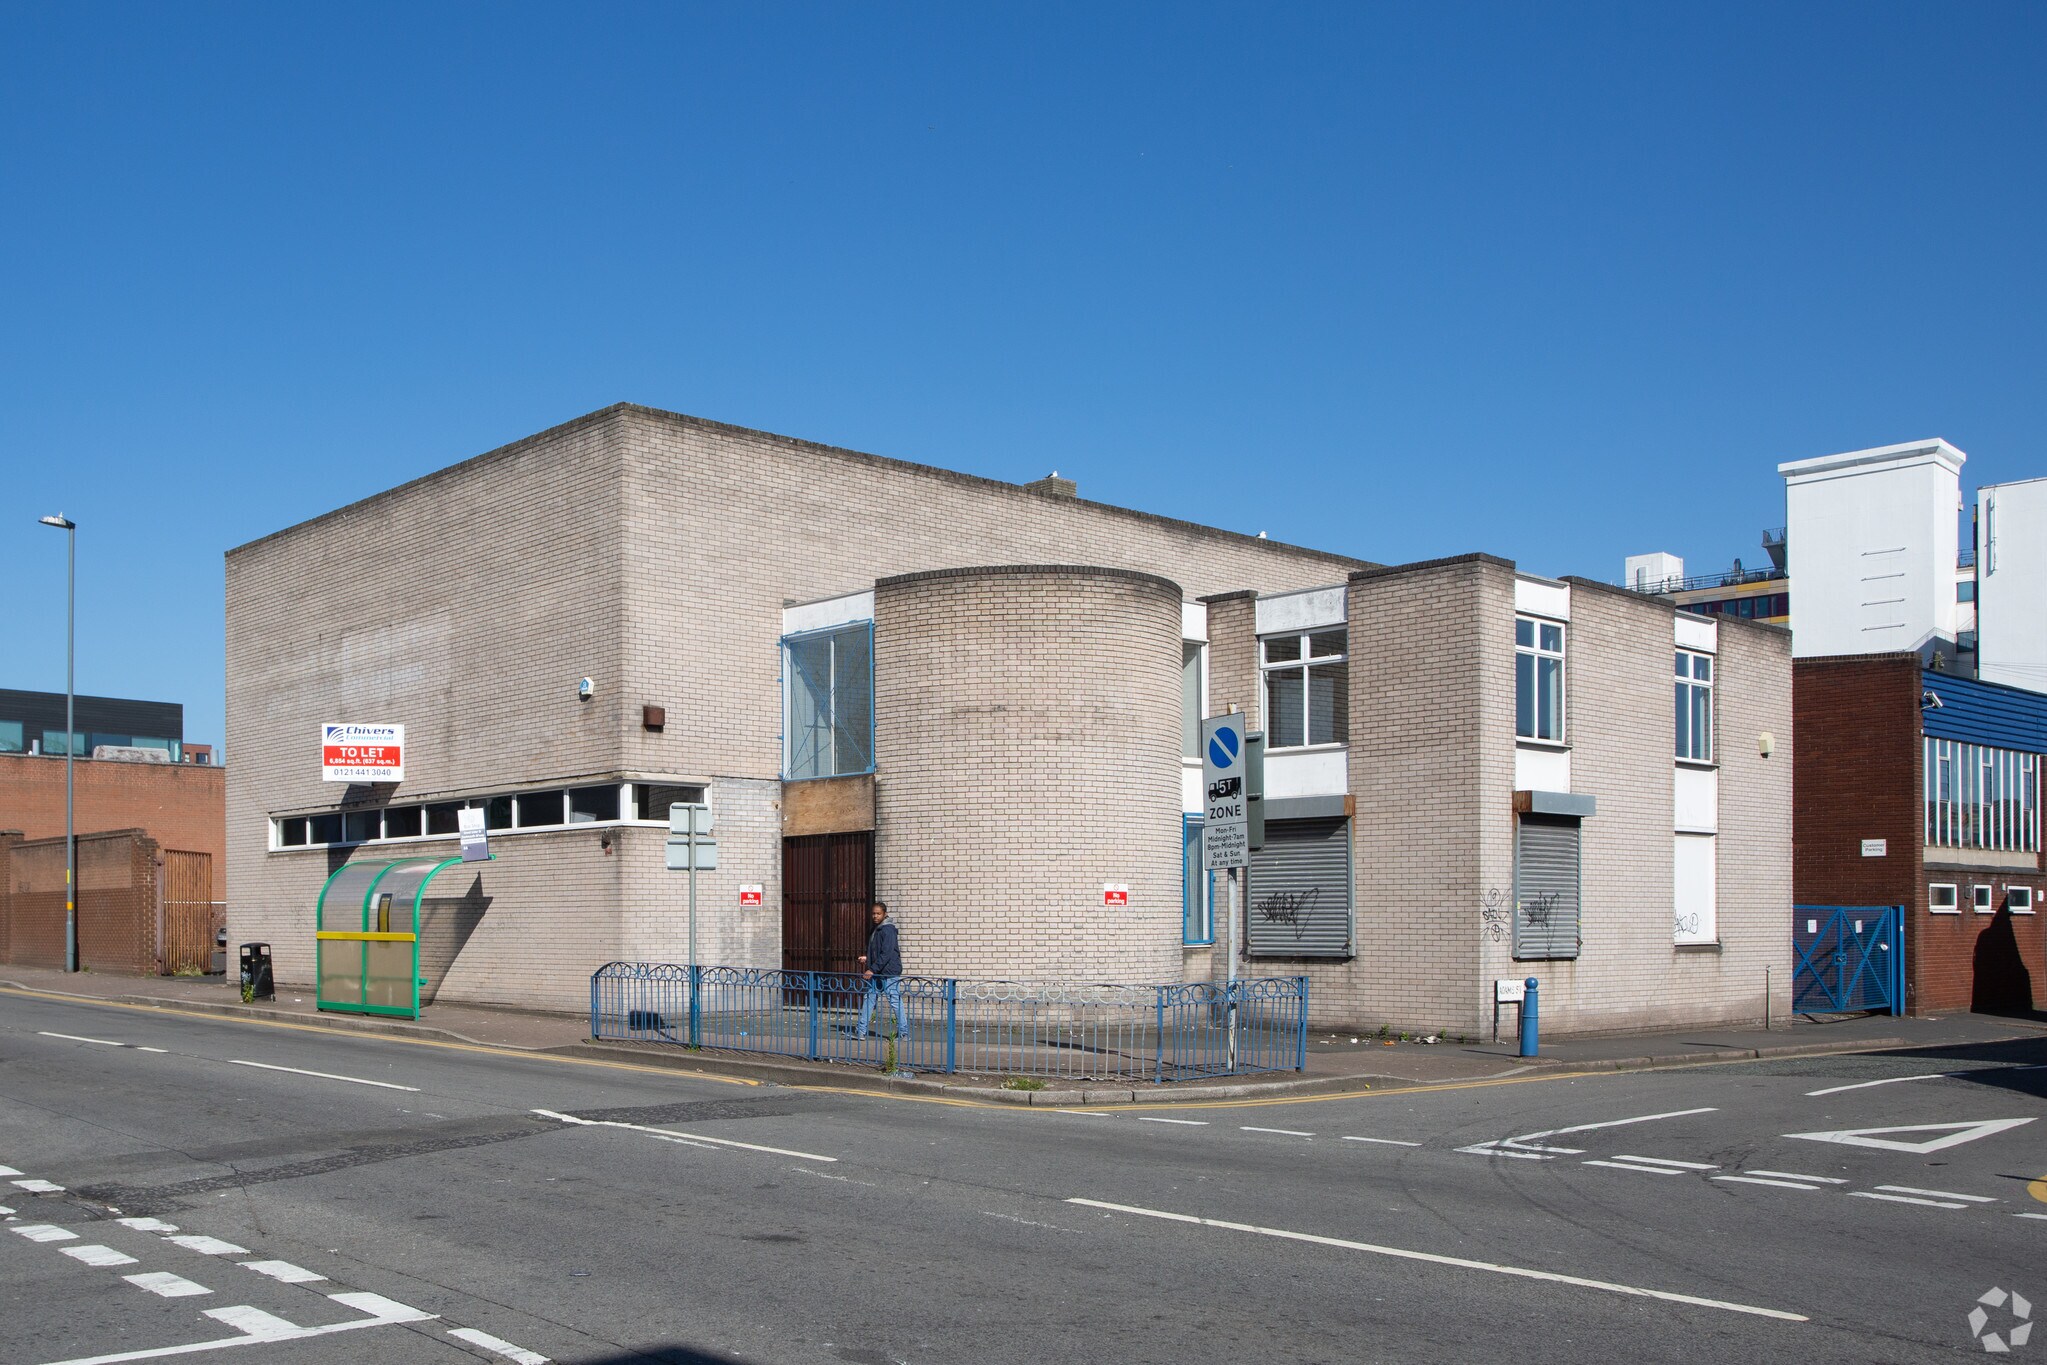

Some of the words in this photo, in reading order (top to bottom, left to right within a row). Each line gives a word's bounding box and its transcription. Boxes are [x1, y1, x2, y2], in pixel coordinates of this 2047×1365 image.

[346, 726, 395, 735] Chivers
[340, 747, 358, 758] TO
[360, 747, 385, 758] LET
[1219, 779, 1232, 794] 5T
[1210, 804, 1241, 820] ZONE
[1215, 826, 1237, 834] Mon-Fri
[1207, 833, 1245, 842] Midnight-7am
[1207, 841, 1246, 851] 8pm-Midnight
